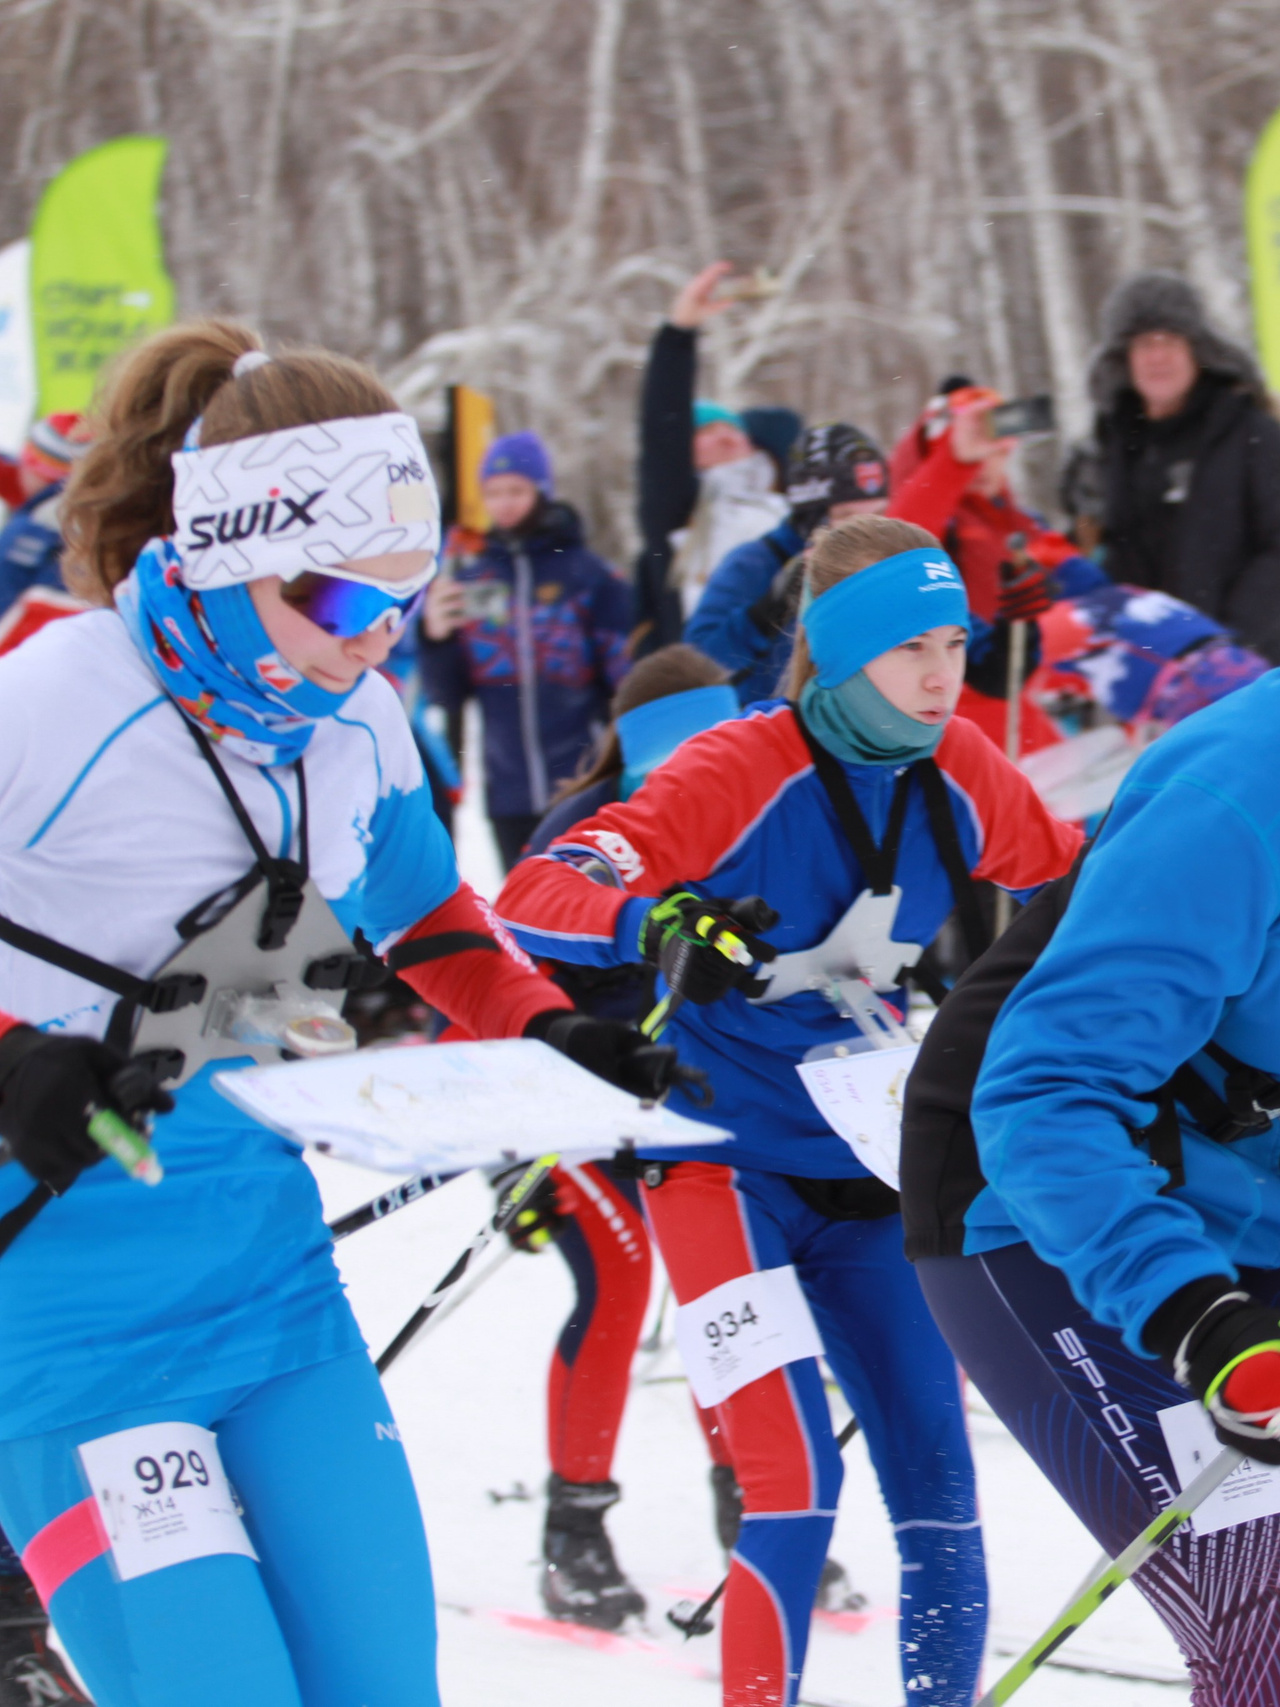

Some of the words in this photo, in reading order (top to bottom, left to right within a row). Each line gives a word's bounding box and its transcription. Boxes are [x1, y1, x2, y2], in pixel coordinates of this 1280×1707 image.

[704, 1301, 758, 1348] 934
[134, 1449, 210, 1495] 929
[132, 1496, 176, 1520] Ж14
